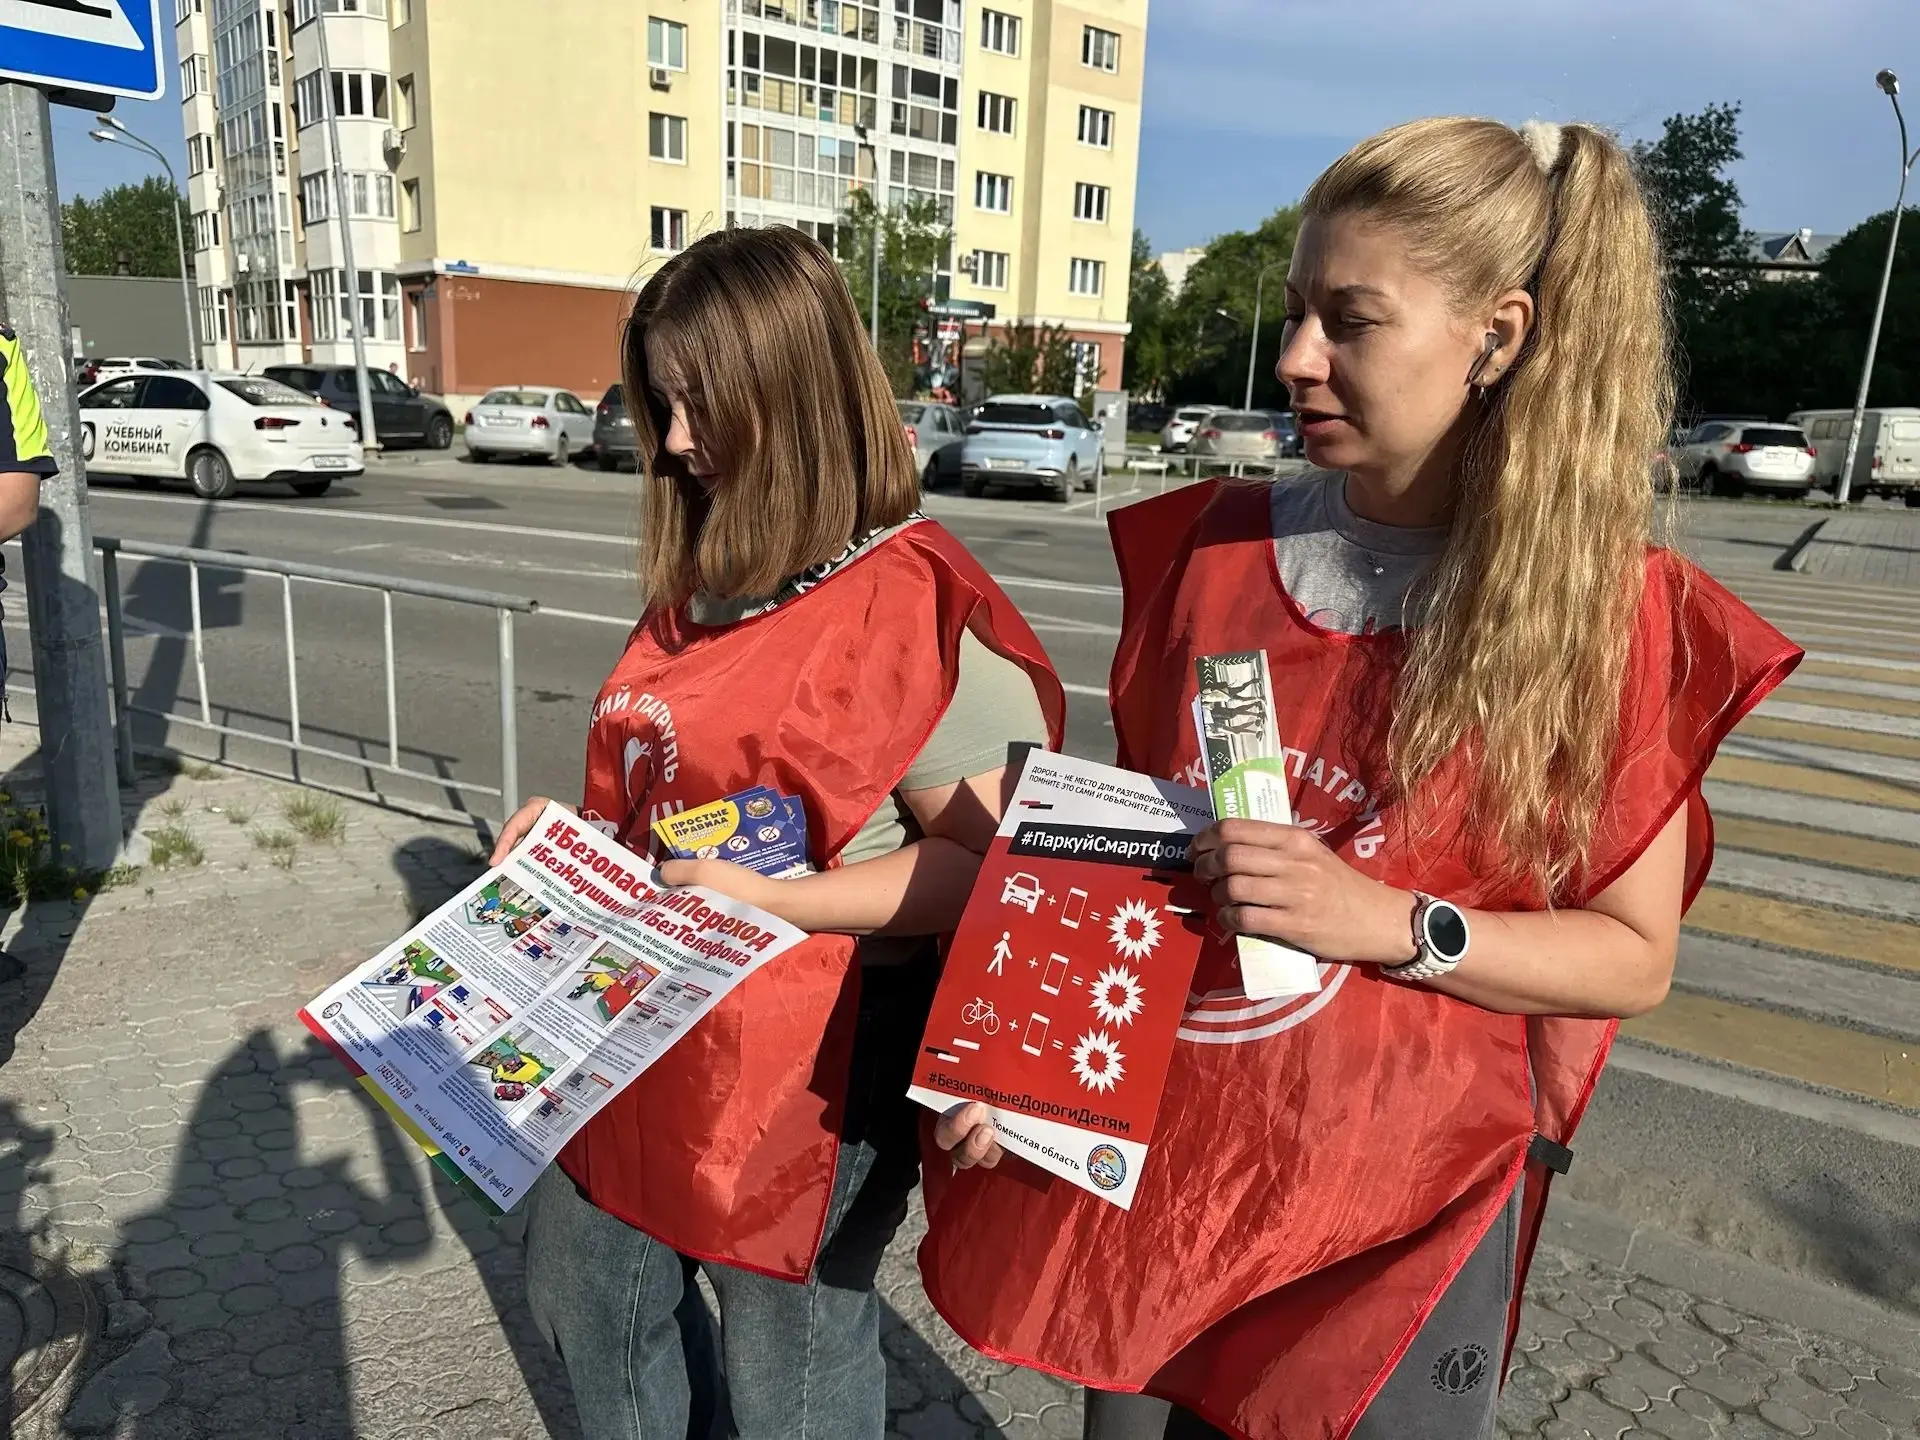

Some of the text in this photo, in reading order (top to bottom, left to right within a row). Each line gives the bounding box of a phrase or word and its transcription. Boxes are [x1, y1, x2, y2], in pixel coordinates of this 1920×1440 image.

[104, 440, 170, 455] КОМБИНАТ
[106, 425, 163, 440] УЧЕБНЫЙ
[632, 693, 679, 784] ПАТРУЛЬ
[670, 808, 729, 830] ПРОСТЫЕ
[1029, 774, 1181, 821] ПОМНИТЕ ЭТО САМИ И ОБЪЯСНИТЕ ДЕТЯМ!
[1031, 765, 1058, 779] ДОРОГА
[1064, 774, 1075, 783] НЕ
[1075, 776, 1099, 788] МЕСТО
[1098, 782, 1115, 793] ДЛЯ
[1116, 787, 1166, 807] РАЗГОВОРОВ
[1166, 799, 1179, 810] ПО
[1180, 803, 1216, 821] ТЕЛЕФО
[1283, 746, 1386, 859] ПАТРУЛЬ
[674, 817, 729, 837] ПРАВИЛА
[1020, 830, 1188, 861] #ПаркуйСмартфон
[544, 819, 778, 953] #БезопасныйПереход
[540, 888, 571, 913] ПРОПУСКАЮТ
[612, 930, 645, 951] ВНИМАТЕЛЬНО
[643, 947, 666, 965] СМОТРИТЕ
[637, 908, 752, 968] #БезТелефона
[652, 937, 675, 957] ВОДИТЕЛИ
[928, 1071, 1131, 1134] #БезопасныеДорогиДетям
[991, 1117, 1040, 1151] Тюменская
[1041, 1145, 1081, 1171] область
